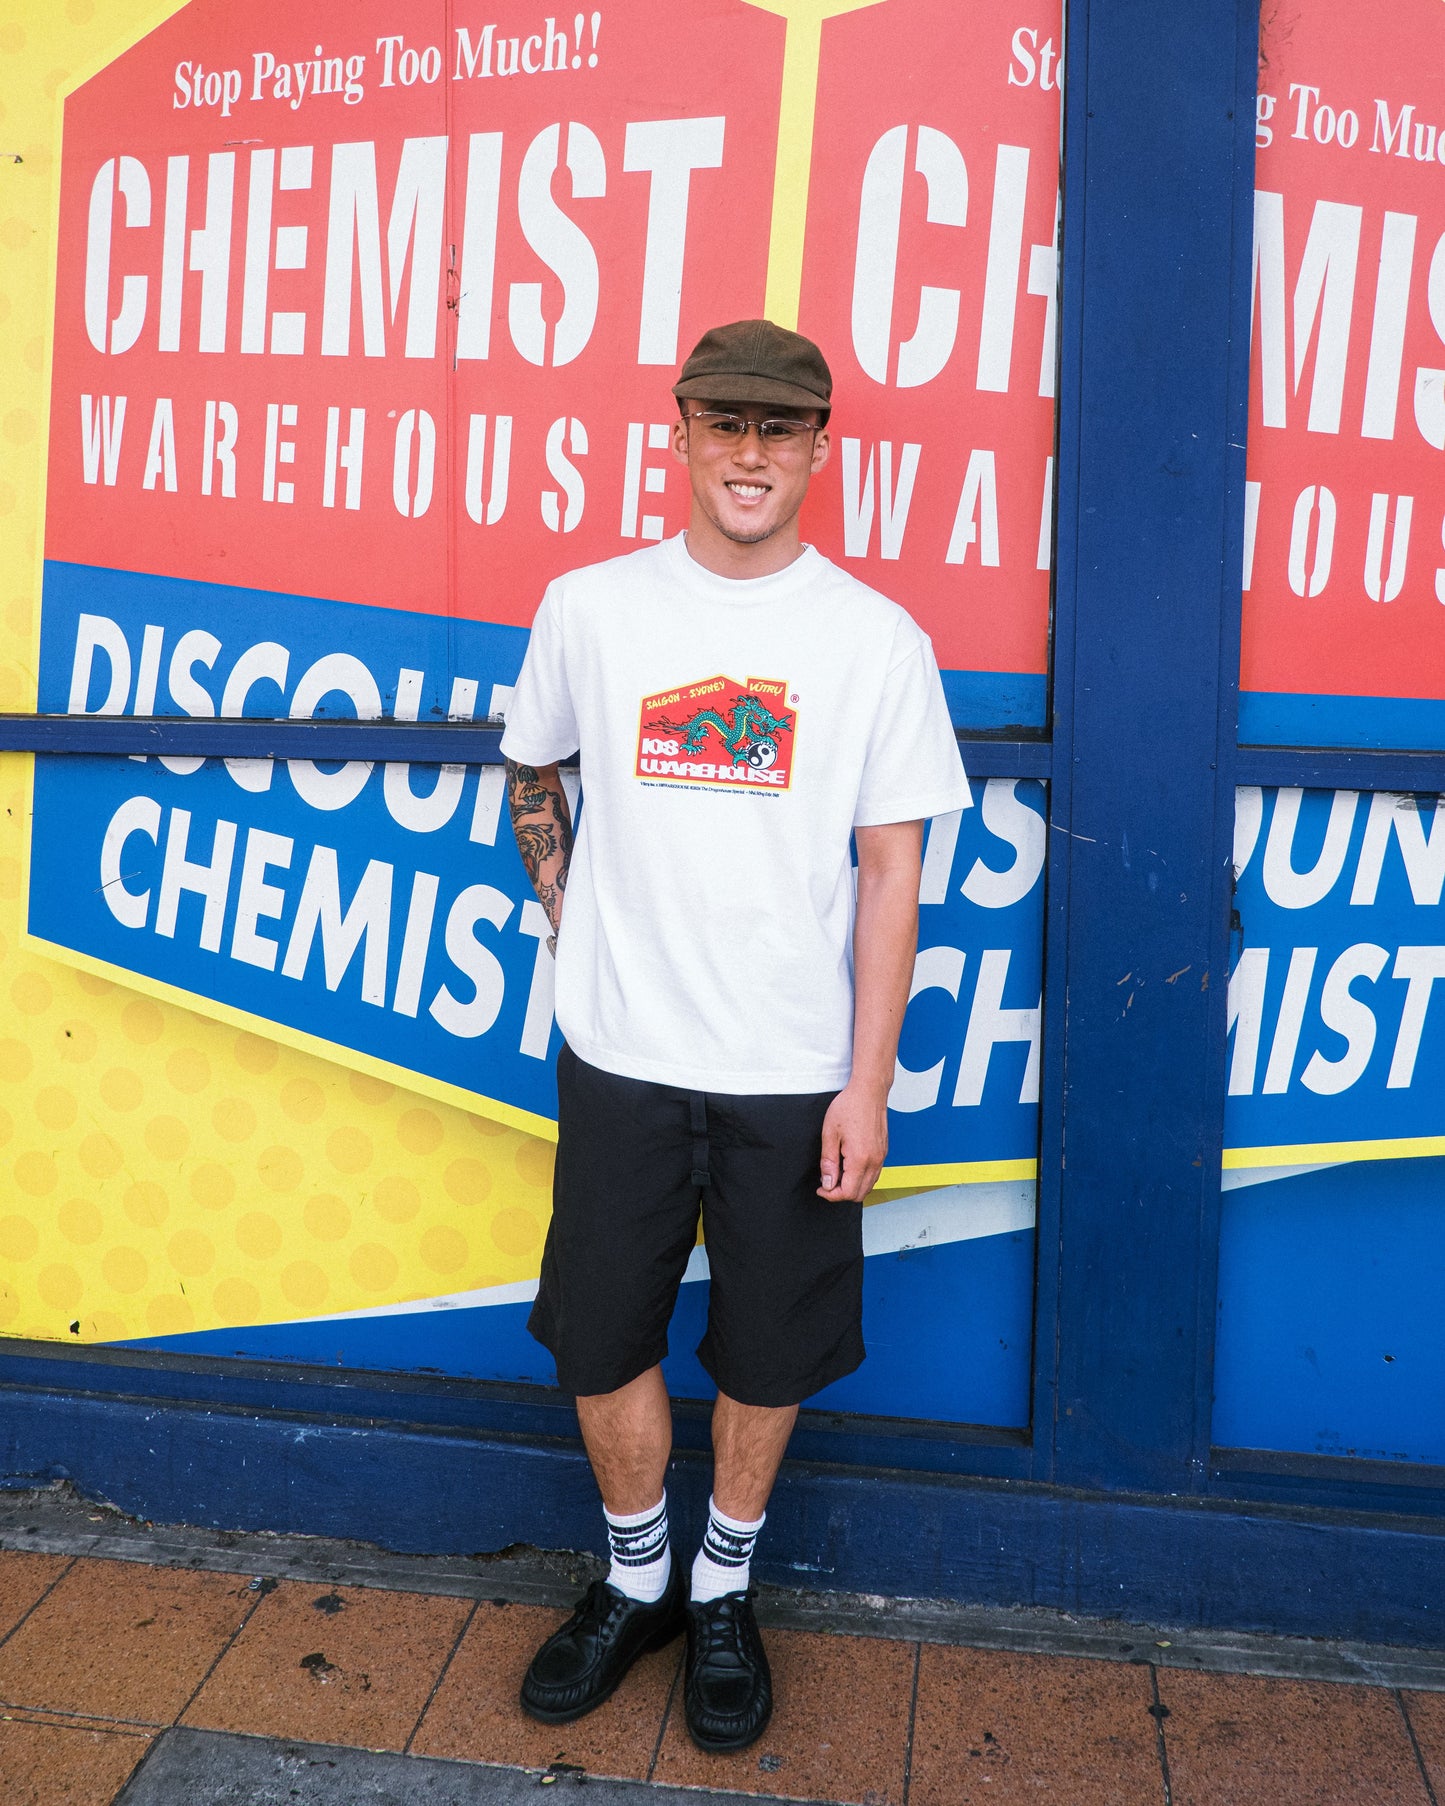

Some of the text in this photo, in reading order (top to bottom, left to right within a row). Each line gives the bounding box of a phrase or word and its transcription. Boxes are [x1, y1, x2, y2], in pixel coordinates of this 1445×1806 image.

[172, 12, 603, 116] Stop Paying Too Much!!
[1288, 82, 1359, 149] Too
[84, 115, 727, 368] CHEMIST
[80, 393, 673, 541] WAREHOUSE
[689, 680, 726, 699] SYDNEY
[640, 758, 786, 785] WAREHOUSE
[641, 737, 679, 757] 108
[100, 796, 557, 1062] CHEMIST
